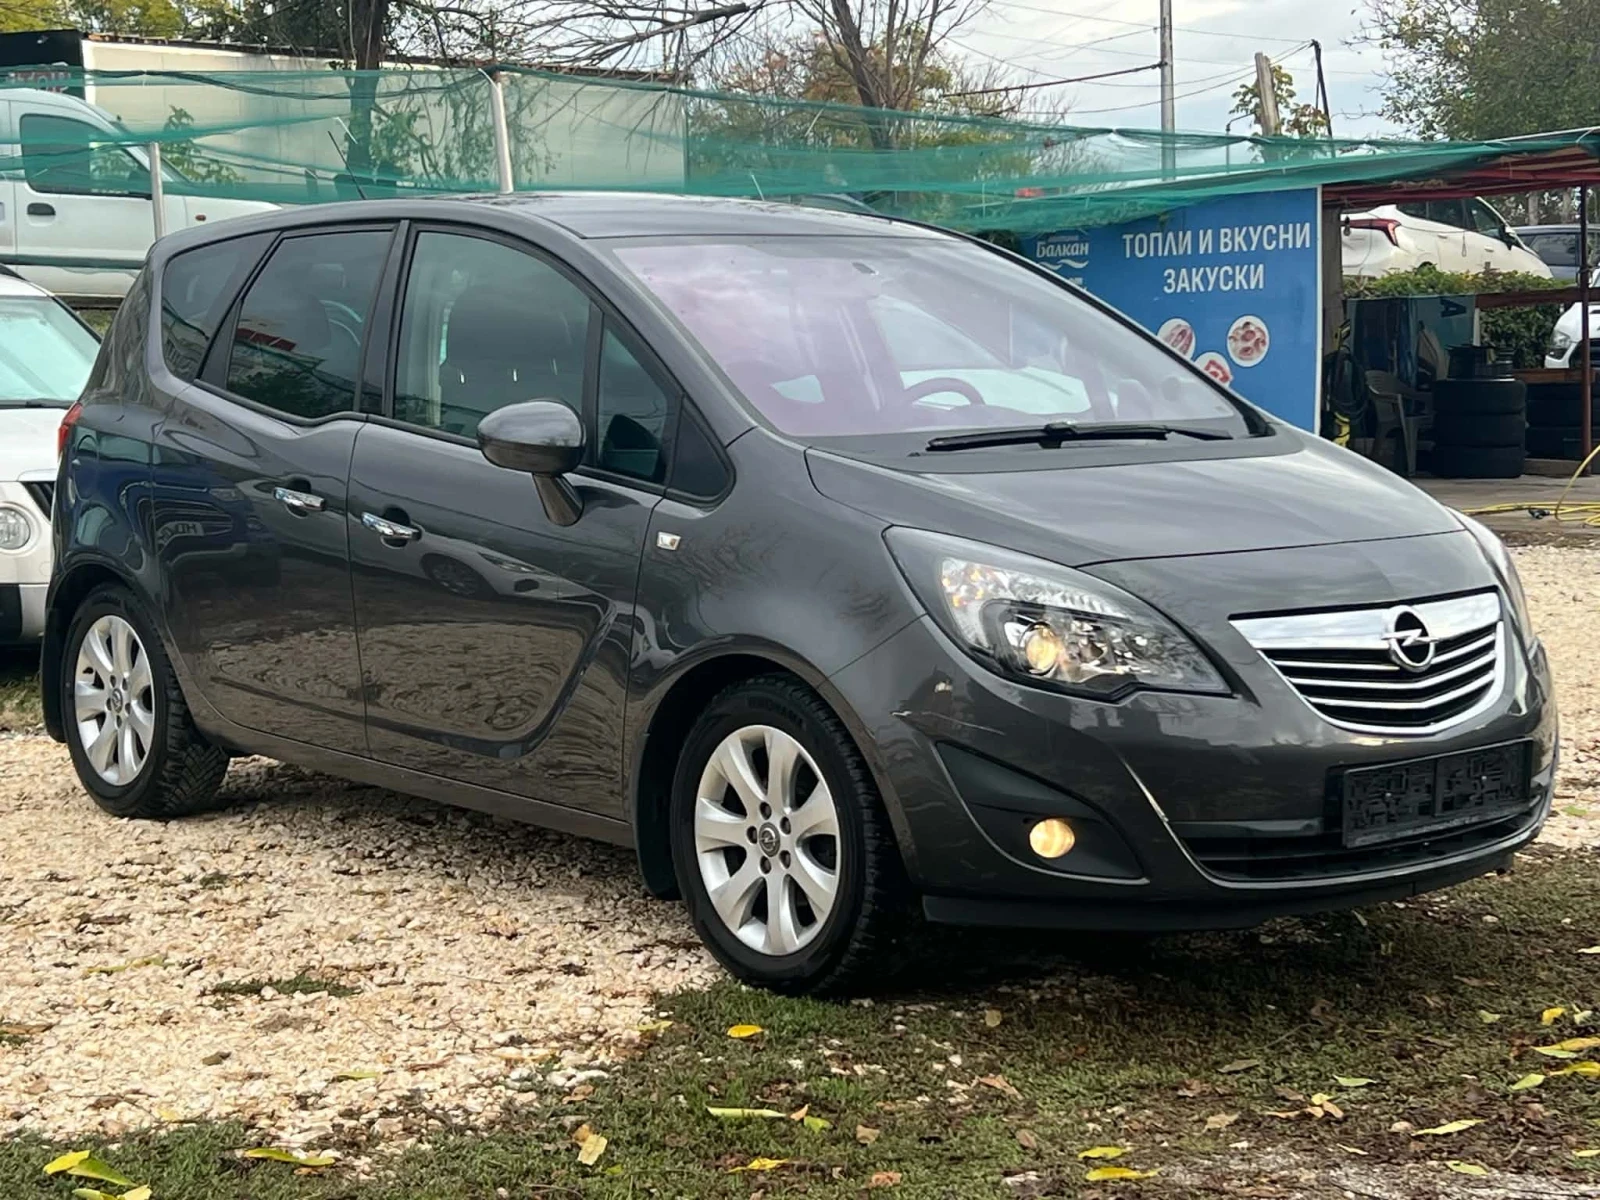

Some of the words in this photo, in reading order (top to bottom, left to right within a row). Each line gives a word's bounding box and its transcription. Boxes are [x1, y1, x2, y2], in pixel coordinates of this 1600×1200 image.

[1036, 241, 1089, 258] Балкан
[1122, 230, 1192, 259] ТОПЛИ
[1198, 228, 1213, 255] И
[1219, 222, 1311, 253] ВКУСНИ
[1163, 264, 1264, 294] ЗАКУСКИ
